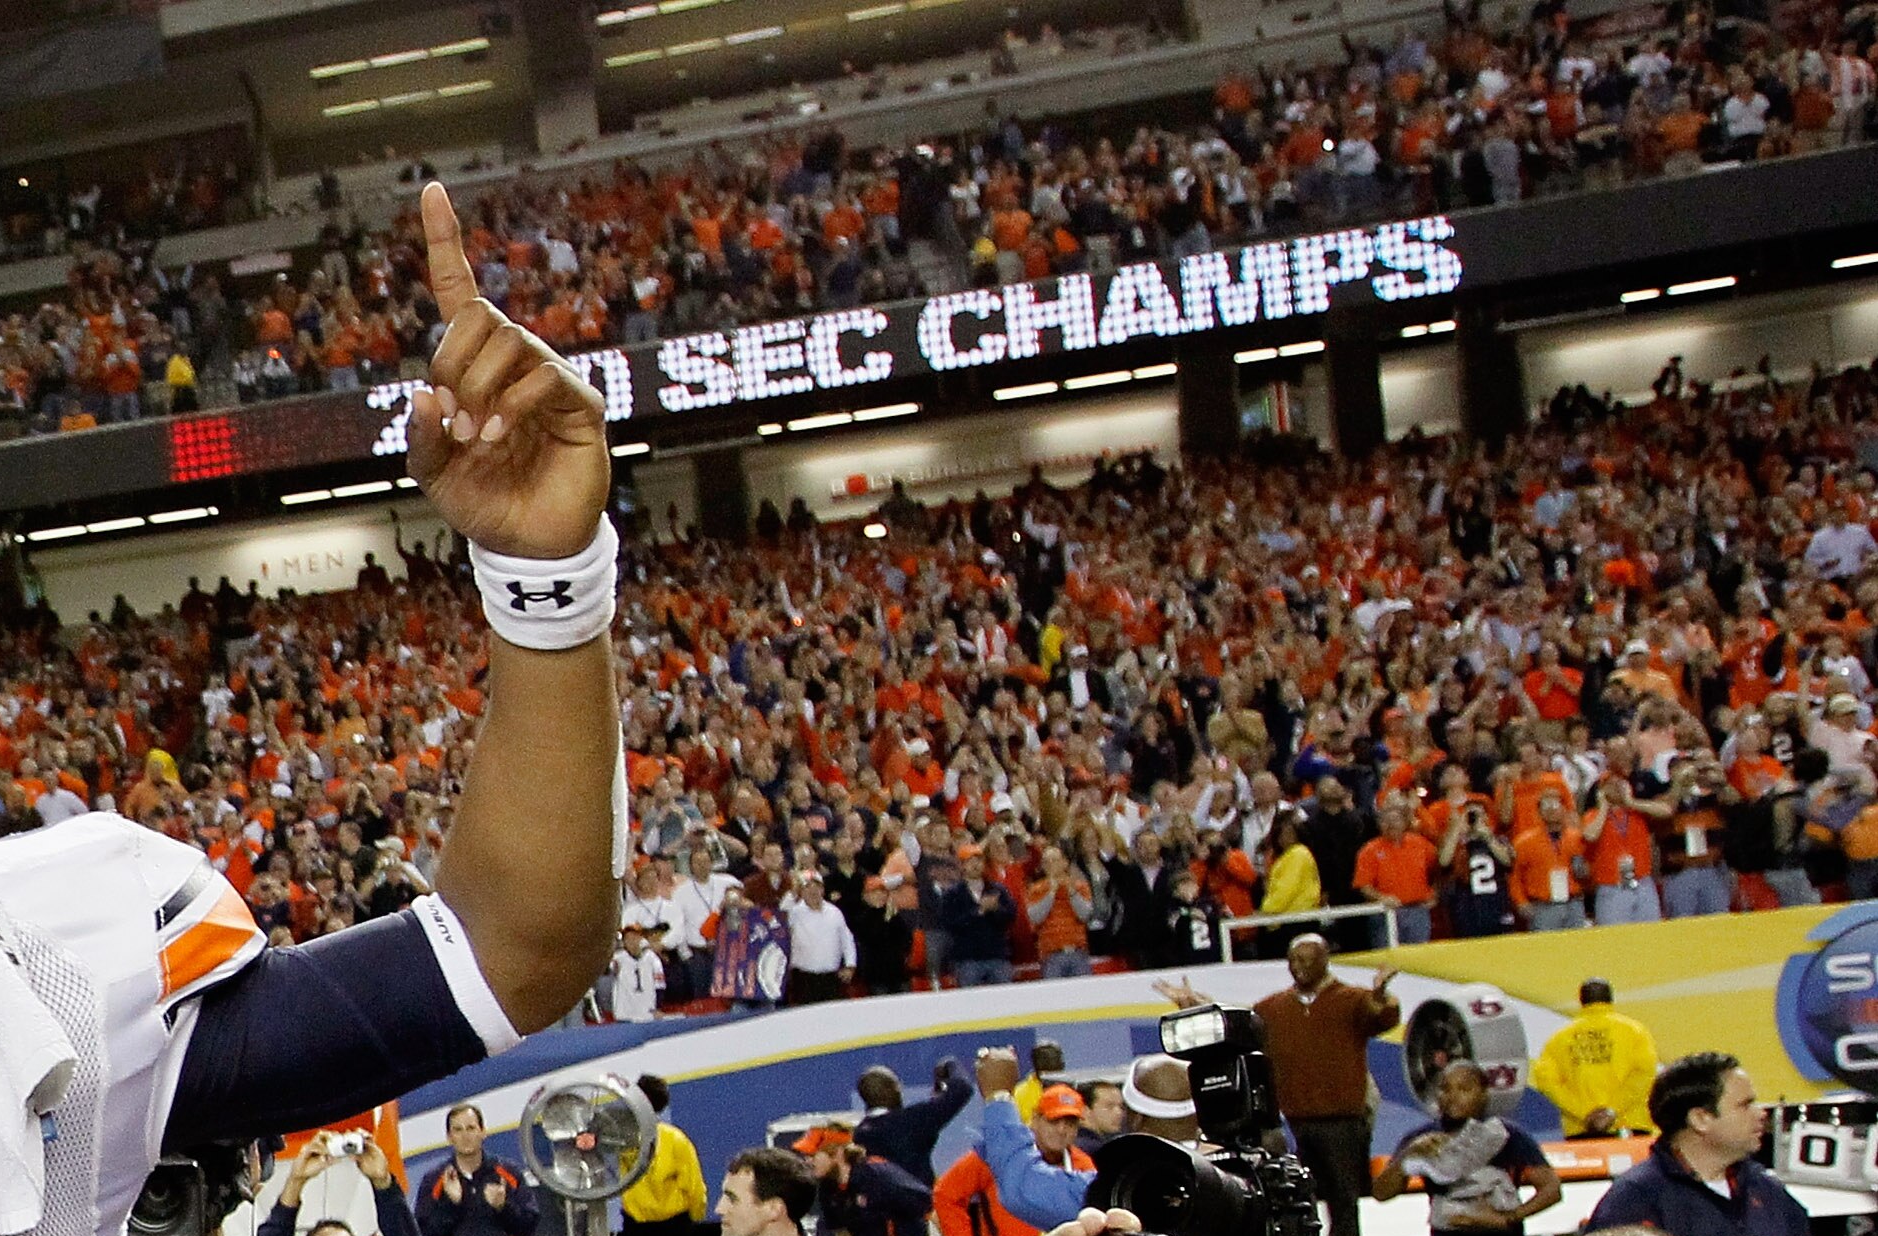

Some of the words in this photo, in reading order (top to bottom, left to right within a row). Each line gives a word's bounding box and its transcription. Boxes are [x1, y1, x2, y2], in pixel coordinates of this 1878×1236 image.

[658, 308, 894, 413] SEC
[917, 215, 1464, 372] CHAMPS
[282, 551, 345, 577] MEN
[1469, 854, 1498, 894] 2
